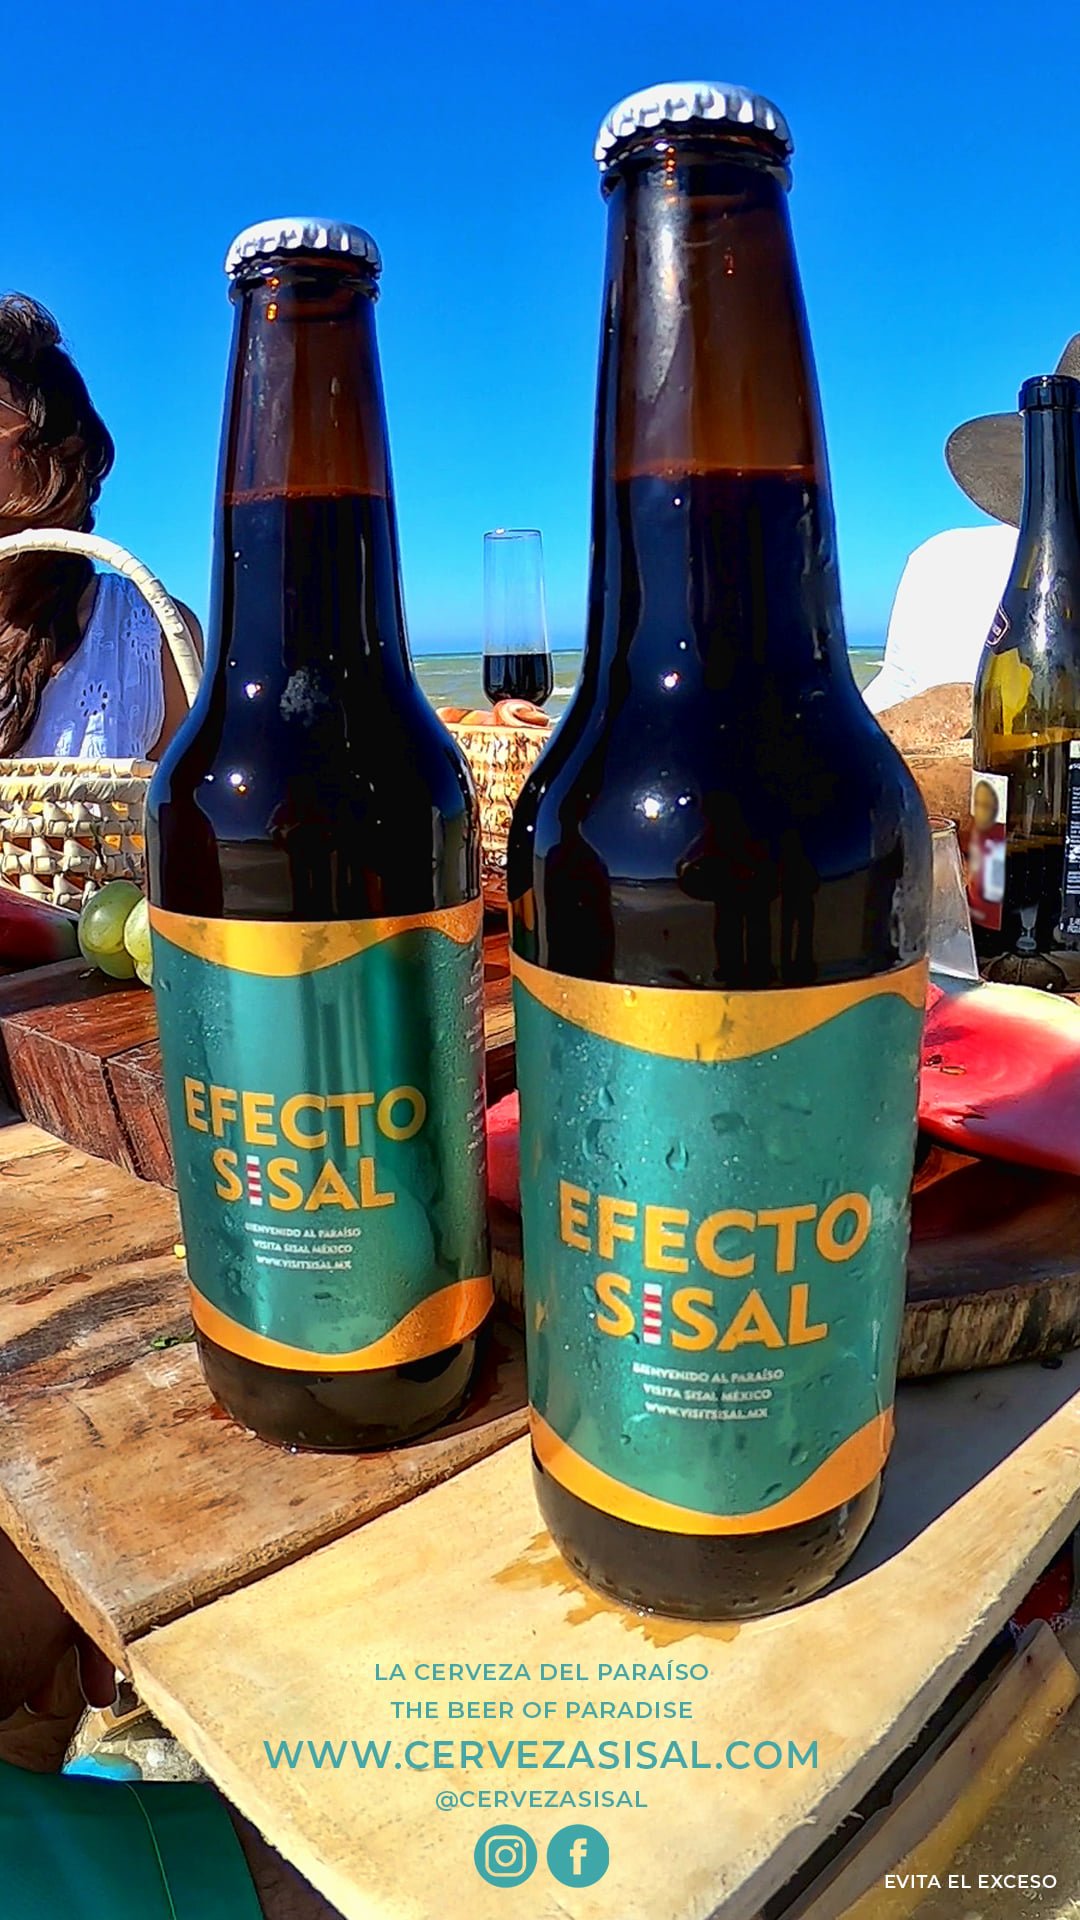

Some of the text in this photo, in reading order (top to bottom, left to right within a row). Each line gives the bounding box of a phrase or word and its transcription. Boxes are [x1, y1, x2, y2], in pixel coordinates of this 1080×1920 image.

[184, 1075, 427, 1150] EFECTO
[212, 1147, 396, 1212] SISAL
[303, 1228, 317, 1238] AL
[559, 1179, 873, 1279] EFECTO
[594, 1272, 829, 1352] SISAL
[632, 1361, 710, 1384] BIENVENIDO
[711, 1371, 729, 1384] AL
[643, 1382, 683, 1400] VISITA
